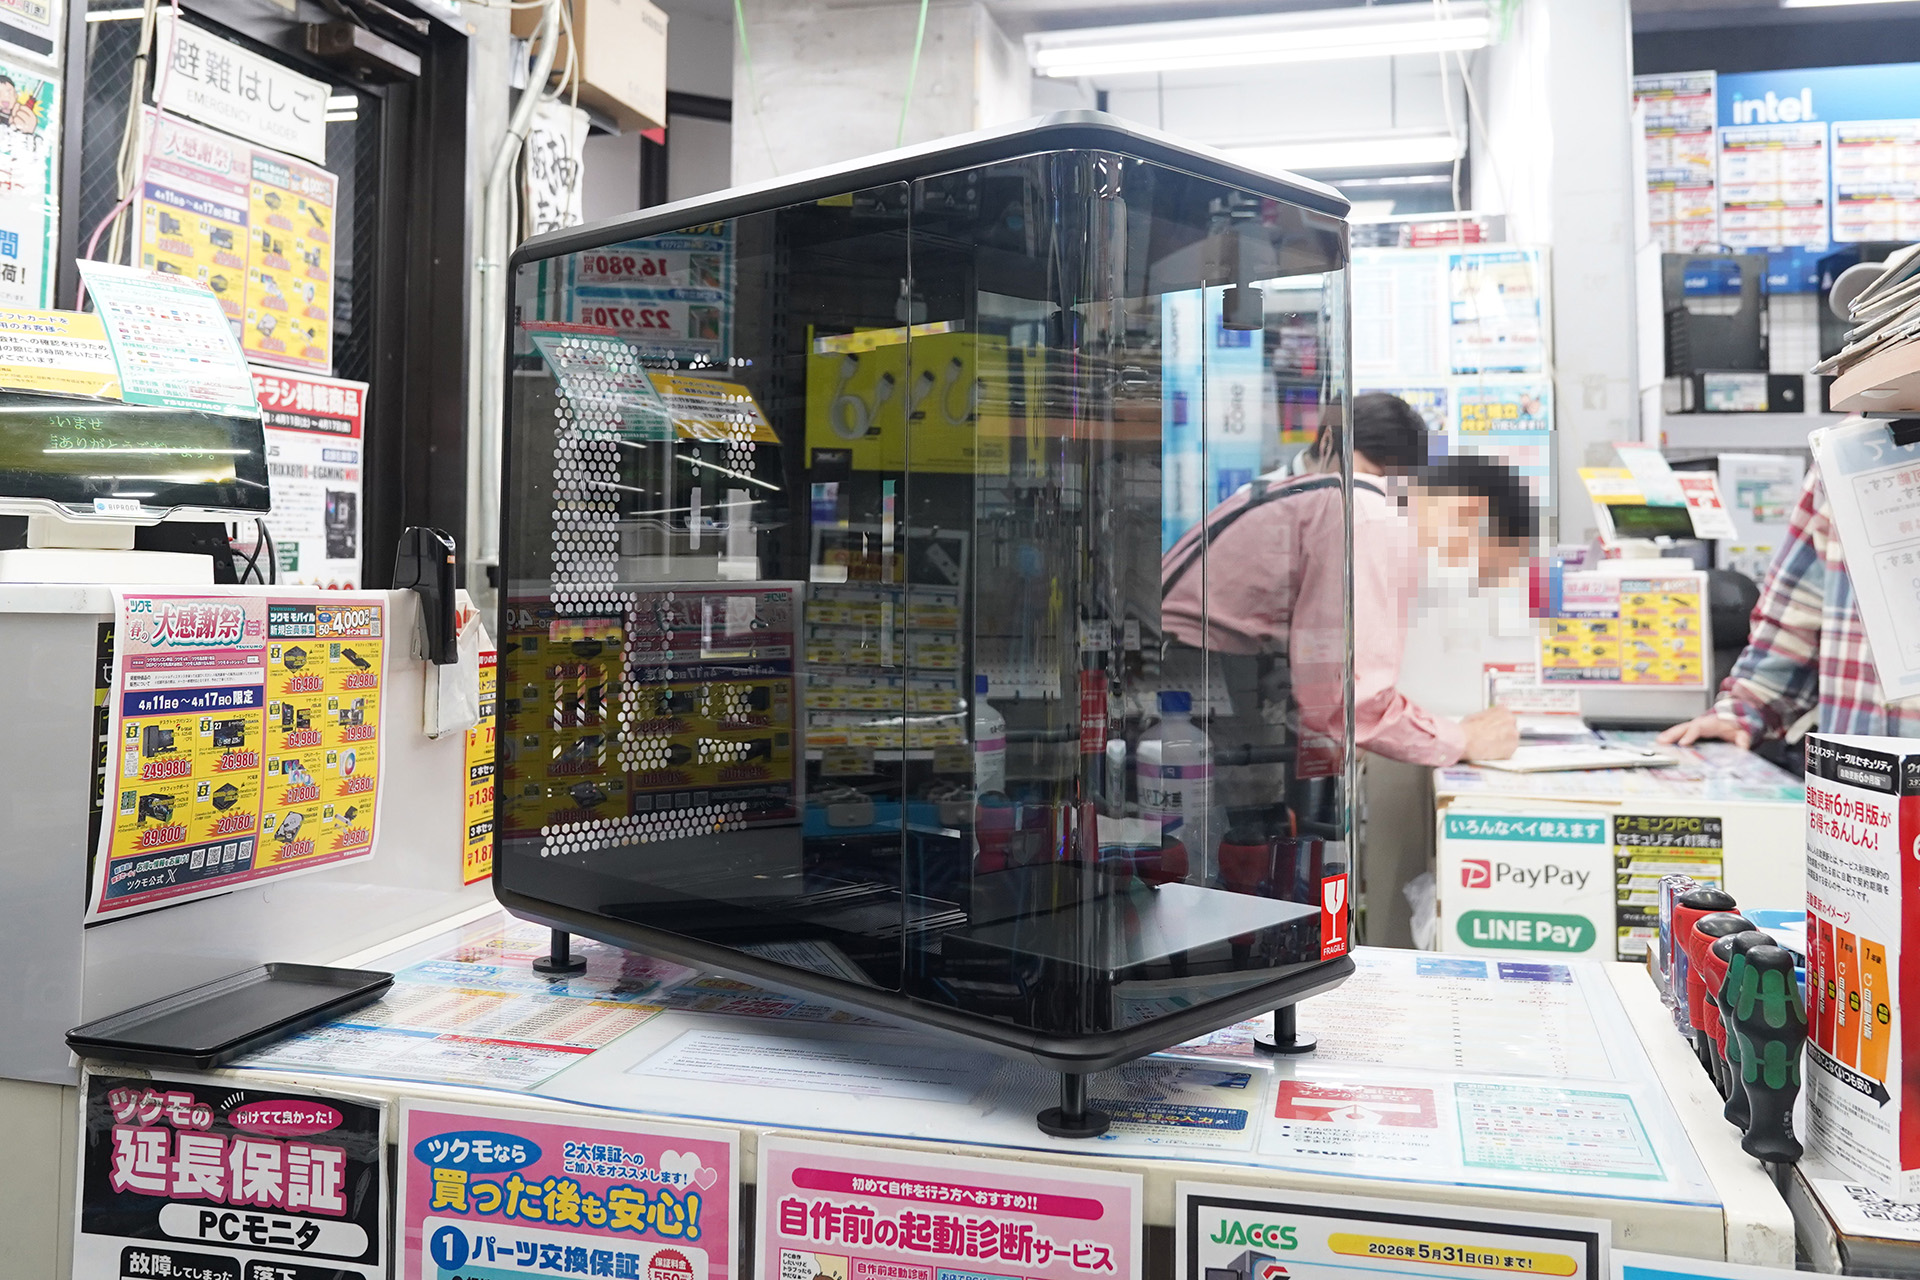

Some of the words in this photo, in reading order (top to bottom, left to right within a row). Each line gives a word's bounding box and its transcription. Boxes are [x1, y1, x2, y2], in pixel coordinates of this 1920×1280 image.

[171, 37, 320, 124] 避難はしご
[1733, 87, 1817, 125] intel
[130, 600, 152, 613] ツクモ
[129, 619, 149, 641] 春の
[152, 603, 241, 640] 大感謝祭
[292, 677, 319, 692] 16,480
[347, 674, 375, 688] 62,980
[288, 732, 317, 747] 64,980
[347, 726, 372, 740] 19,980
[143, 760, 186, 780] 249,980
[222, 753, 254, 769] 26,980
[348, 777, 371, 792] 2,580
[217, 815, 251, 834] 20,780
[1450, 820, 1600, 839] いろんなペイ使えます
[1616, 816, 1700, 832] ゲーミングPC
[143, 826, 181, 847] 89,800
[343, 830, 368, 846] 9,980
[282, 843, 311, 858] 10,980
[127, 875, 164, 890] ツクモ公式
[1495, 862, 1591, 890] PayPay
[1472, 918, 1532, 942] LINE
[1536, 921, 1582, 948] Pay
[1323, 943, 1345, 956] FRAGILE
[111, 1090, 210, 1127] ツクモの
[236, 1110, 333, 1125] 付けてて良かった!
[427, 1139, 527, 1164] ツクモなら
[564, 1142, 644, 1165] 2大保証への
[113, 1129, 343, 1211] 延長保証
[564, 1162, 688, 1186] ご加入をオススメします!
[431, 1168, 700, 1239] 買った後も安心!
[851, 1176, 1038, 1211] 初めて自作を行う方へおすすめ!!
[199, 1210, 321, 1251] PCモニタ
[780, 1198, 1115, 1273] 自作前の起動診断サービス
[1209, 1218, 1299, 1251] JACCS
[129, 1251, 233, 1280] 故障してしまった
[472, 1235, 641, 1280] パーツ交換保証
[857, 1262, 929, 1280] 自作前起動診断
